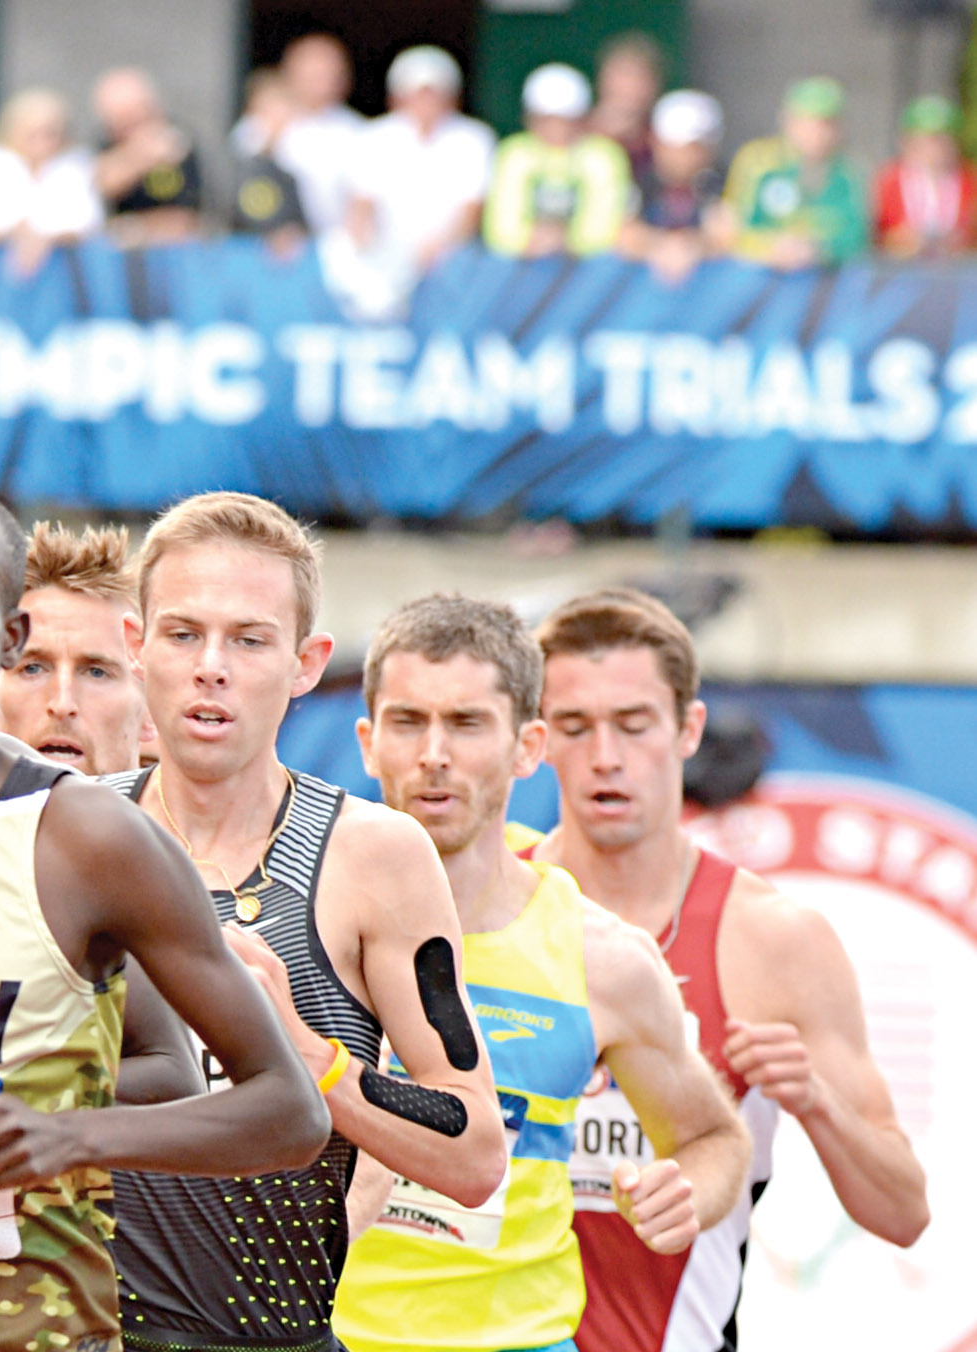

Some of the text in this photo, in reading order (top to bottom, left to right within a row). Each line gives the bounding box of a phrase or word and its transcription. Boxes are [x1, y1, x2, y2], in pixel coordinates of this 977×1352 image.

[274, 324, 576, 433] TEAM
[583, 330, 942, 444] TRIALS
[474, 1004, 554, 1030] BROOKS
